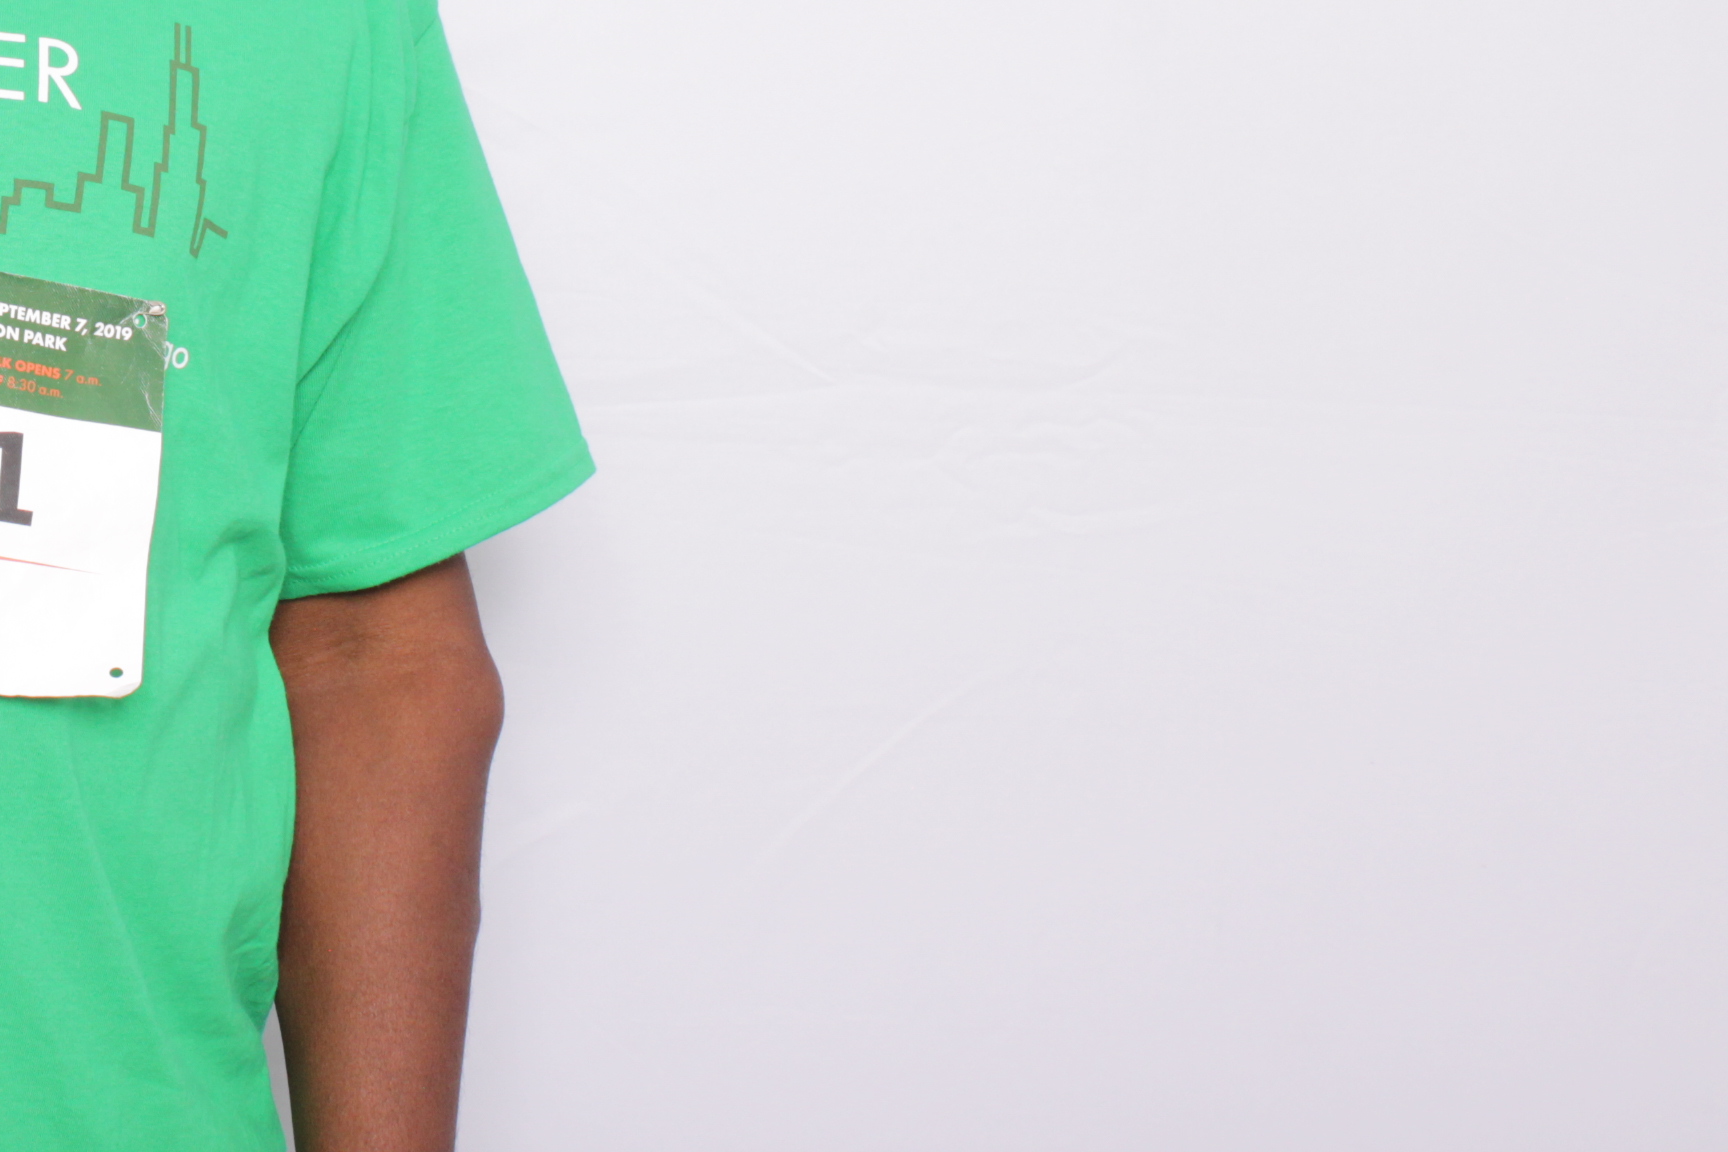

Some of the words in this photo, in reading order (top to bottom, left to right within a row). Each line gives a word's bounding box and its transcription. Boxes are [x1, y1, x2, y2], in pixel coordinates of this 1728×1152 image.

[23, 330, 68, 352] PARK
[75, 318, 88, 336] 7,
[93, 322, 133, 342] 2019
[14, 359, 62, 380] OPENS
[64, 369, 75, 381] 7
[75, 372, 103, 386] a.m.
[6, 375, 37, 392] 8:30
[38, 384, 64, 398] a.m.
